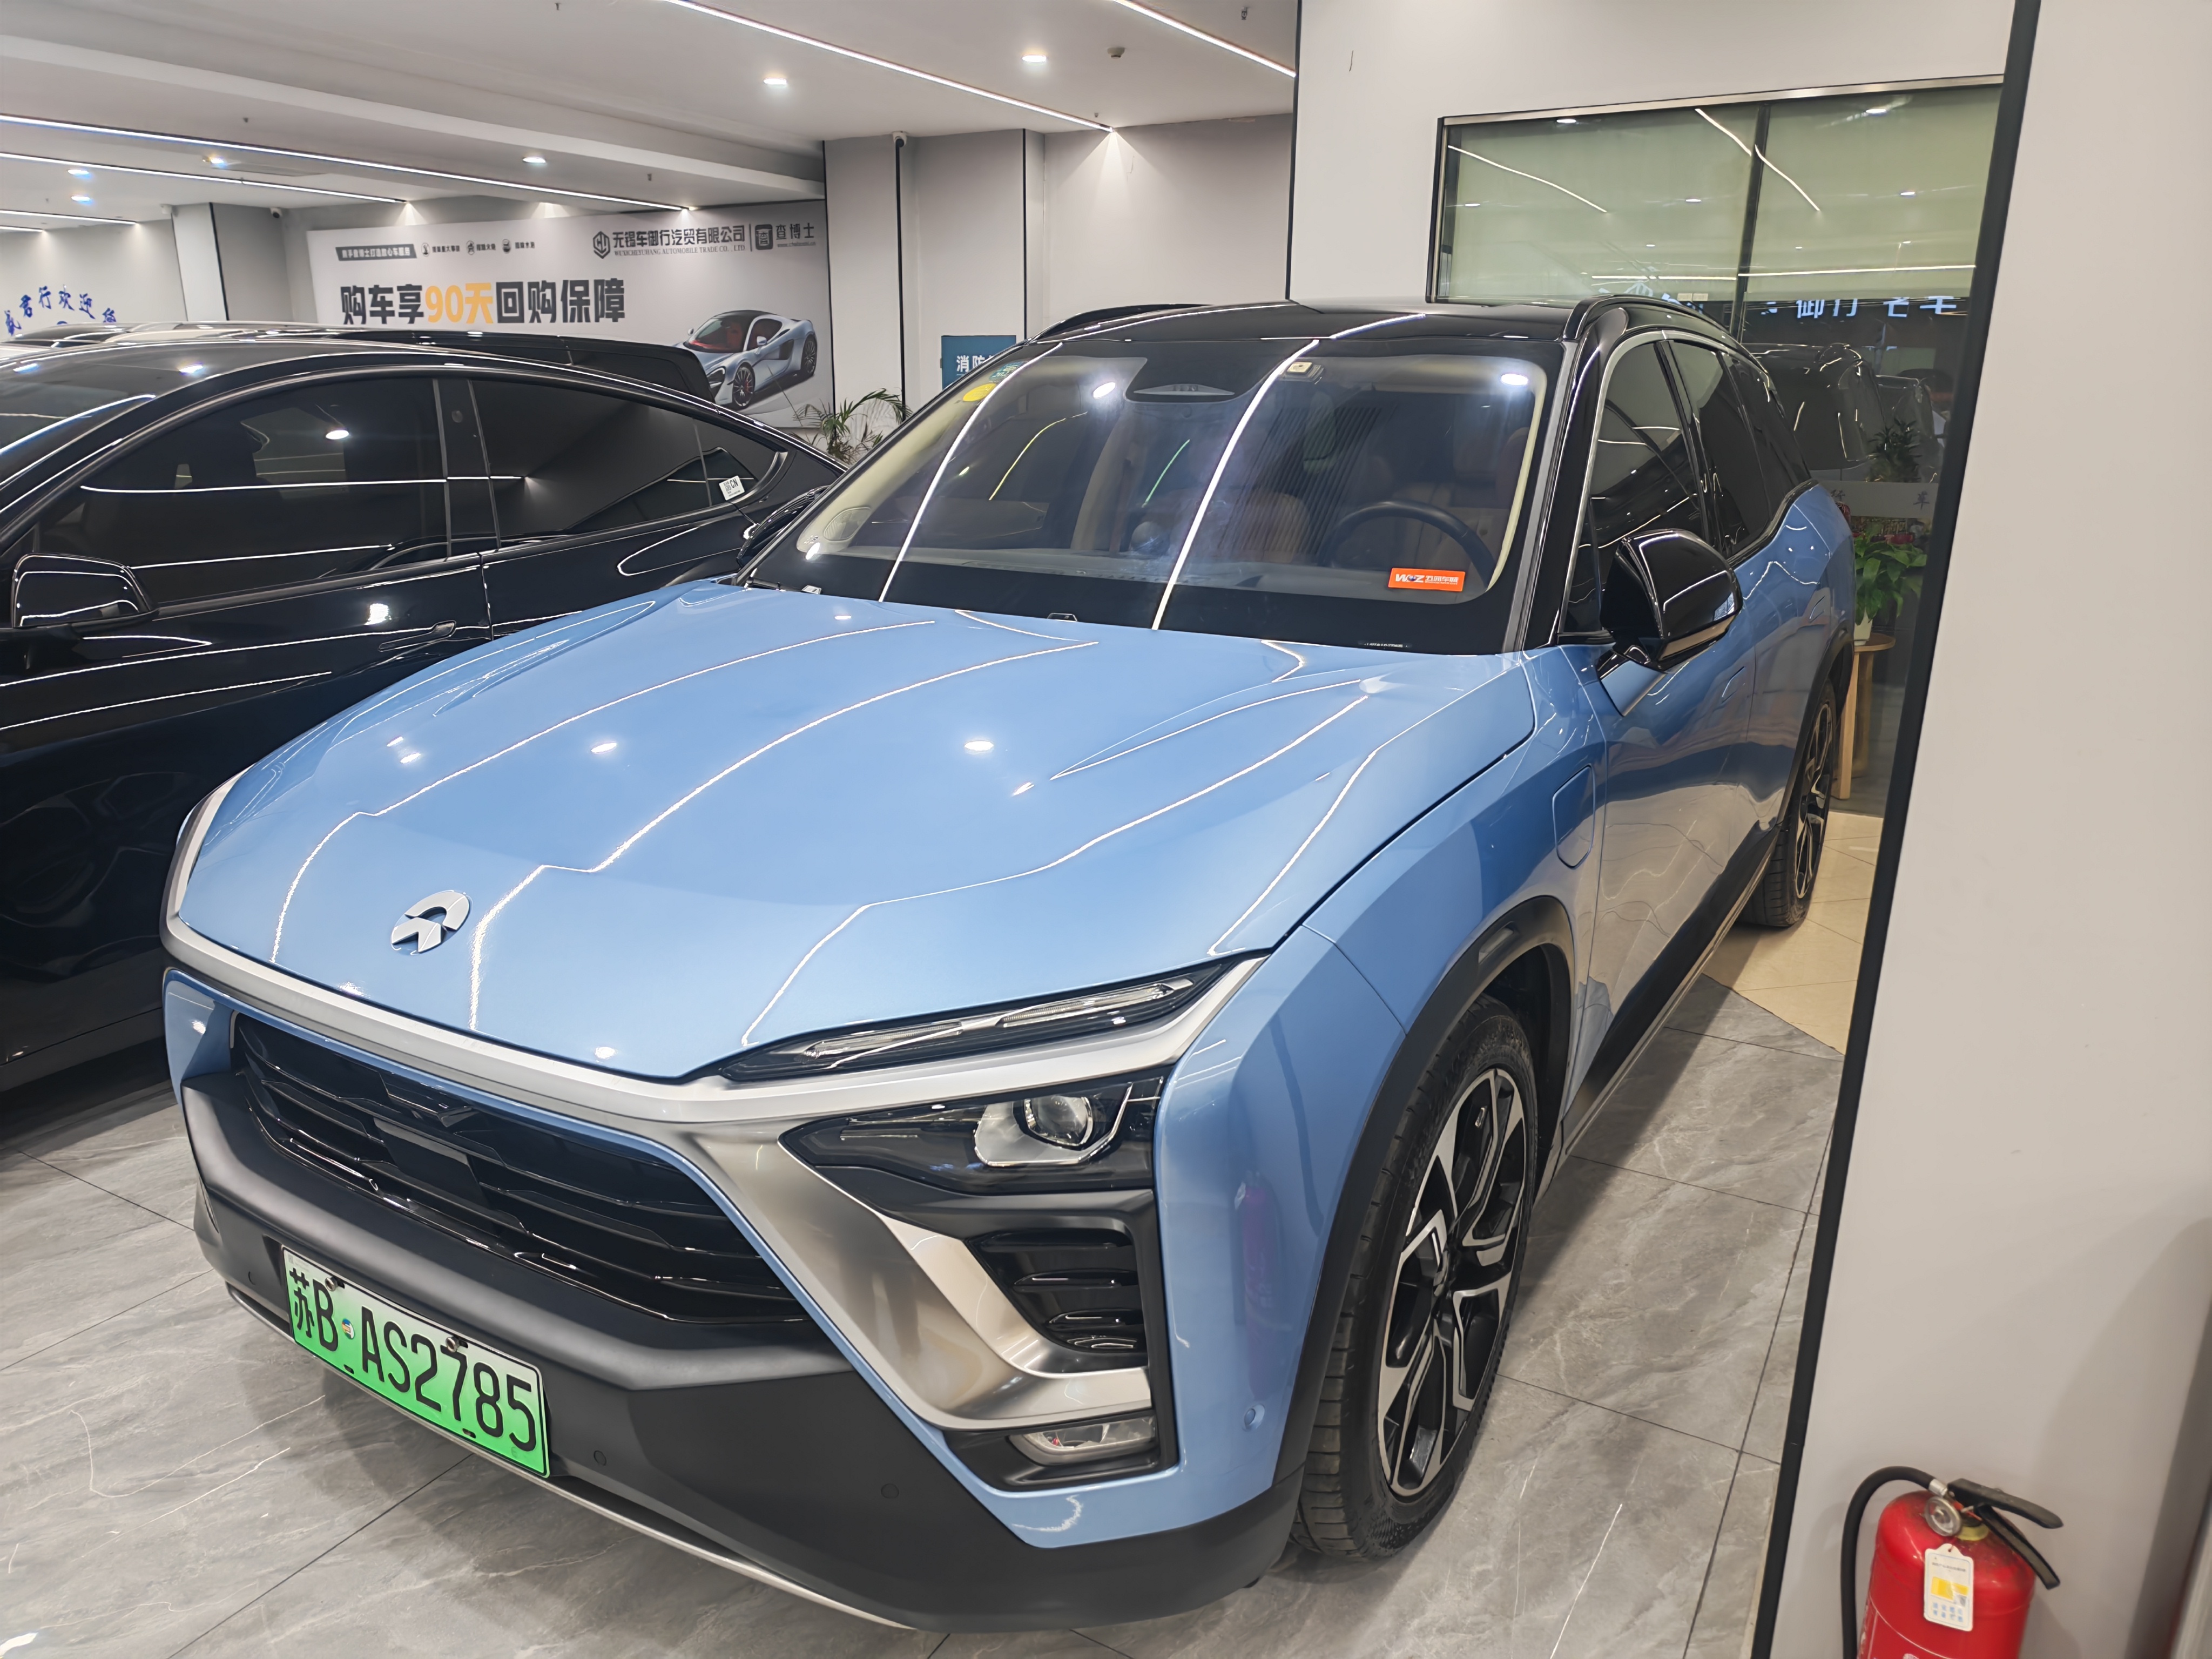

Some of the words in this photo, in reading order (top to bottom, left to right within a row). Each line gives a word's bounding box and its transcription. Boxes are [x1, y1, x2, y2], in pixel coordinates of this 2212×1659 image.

[612, 225, 745, 248] 无锡车御行汽贸有限公司
[776, 222, 814, 240] 查博士
[341, 278, 625, 324] 购车享90天回购保障
[956, 355, 995, 372] 消防
[730, 478, 739, 488] CN
